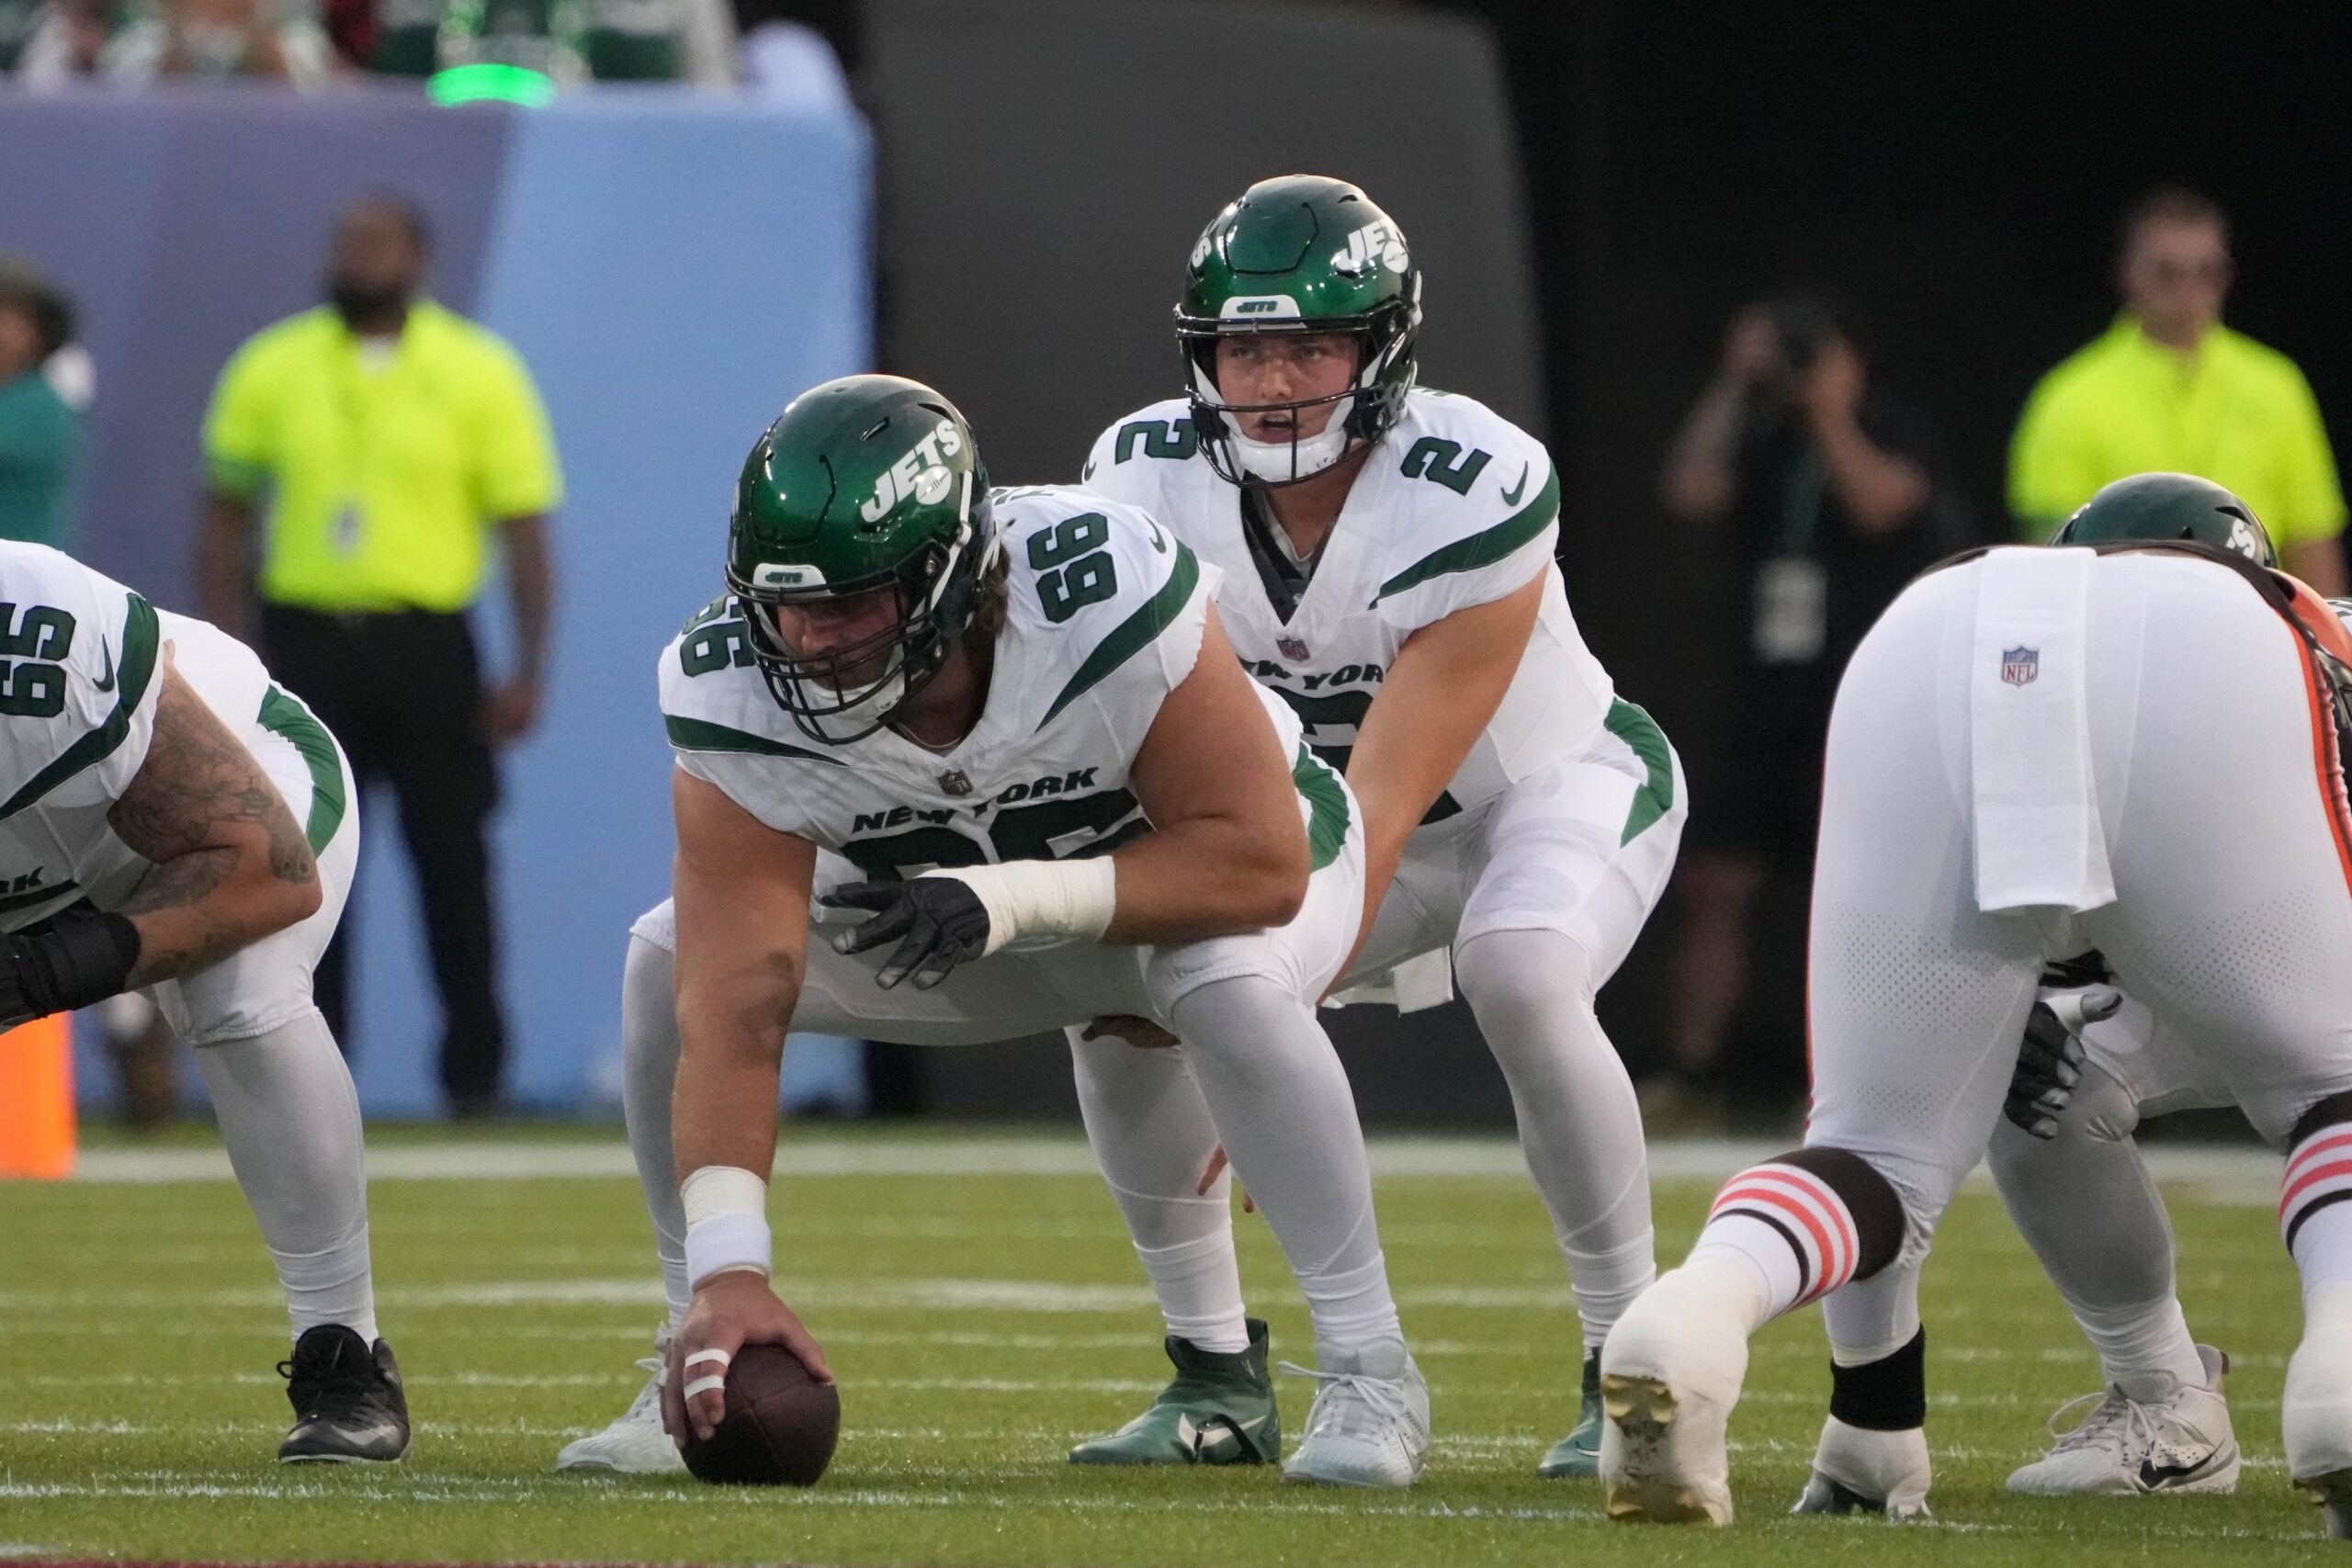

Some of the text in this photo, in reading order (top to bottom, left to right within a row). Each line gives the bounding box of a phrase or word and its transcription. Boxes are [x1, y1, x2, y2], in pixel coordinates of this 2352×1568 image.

[1331, 219, 1406, 273] JET
[1236, 300, 1278, 313] JETS
[1115, 419, 1196, 465] 2
[861, 419, 961, 523] JETS
[1400, 435, 1493, 497] 2
[1026, 512, 1118, 624] 66
[1303, 664, 1385, 690] YOR
[2006, 663, 2034, 682] NFL
[851, 805, 957, 834] NEW
